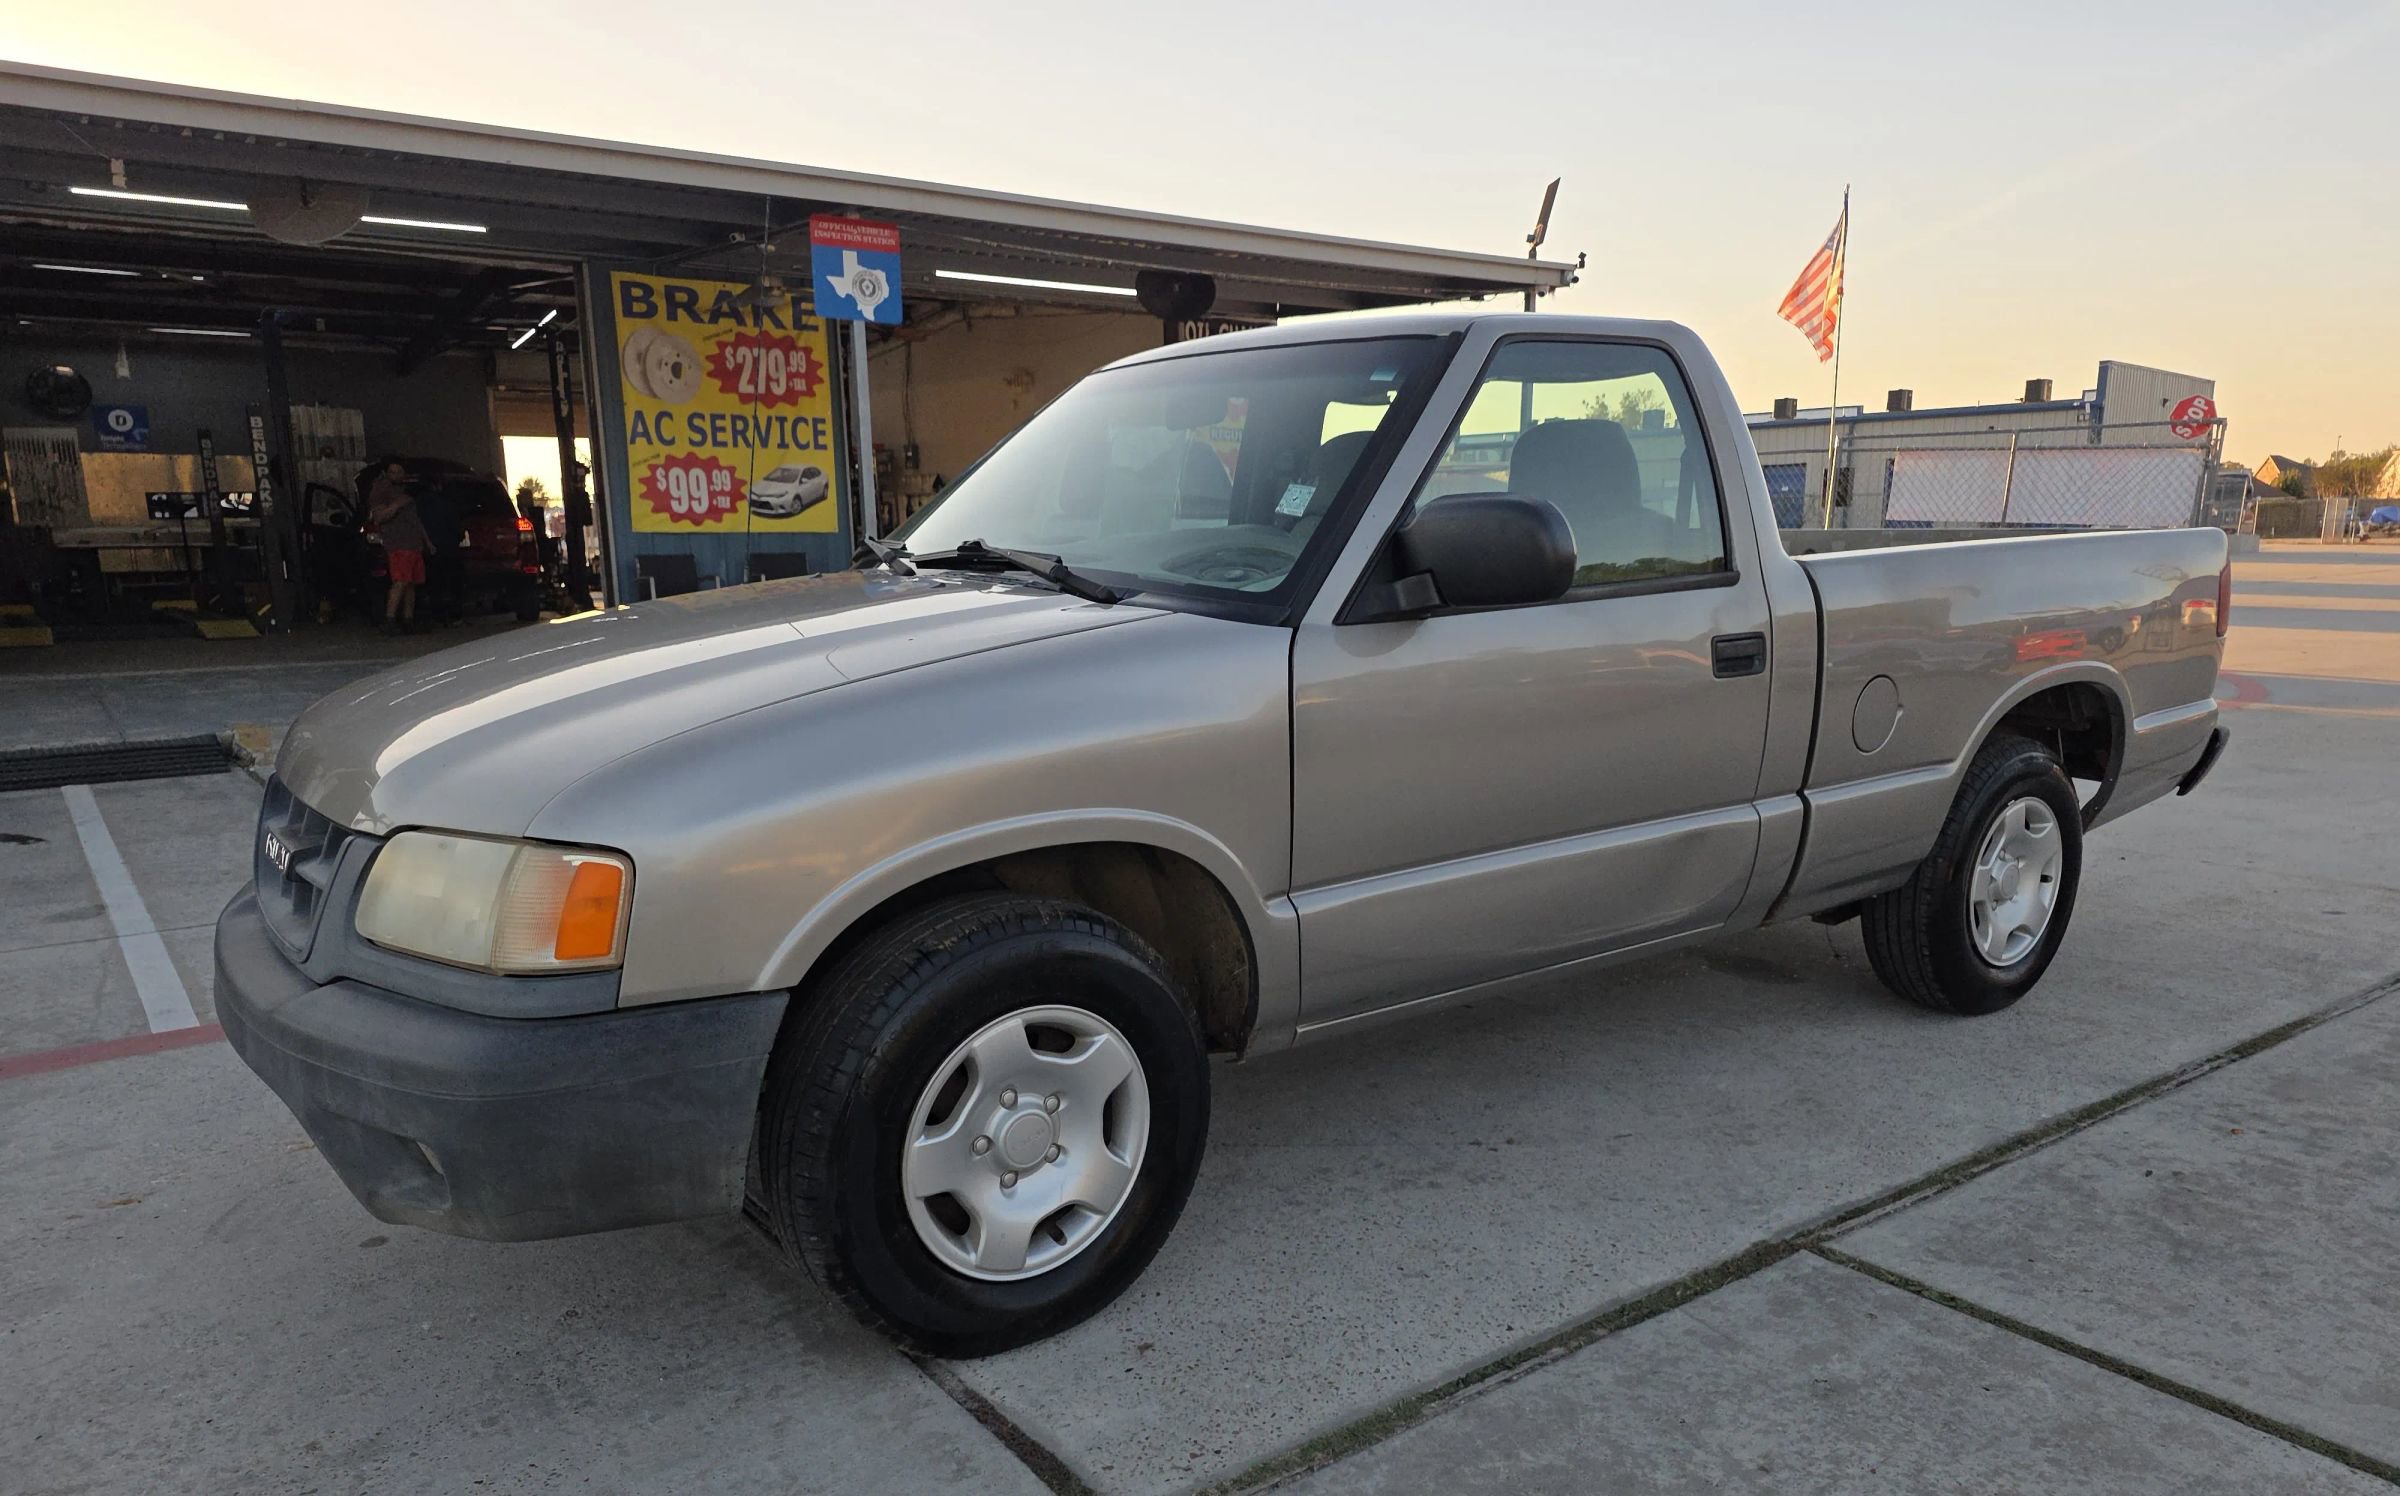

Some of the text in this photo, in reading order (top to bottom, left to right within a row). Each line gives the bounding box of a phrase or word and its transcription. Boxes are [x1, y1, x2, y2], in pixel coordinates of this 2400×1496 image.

[814, 229, 896, 246] INSPECTION STATION
[619, 280, 819, 332] BRAKE
[629, 410, 828, 450] AC SERVICE
